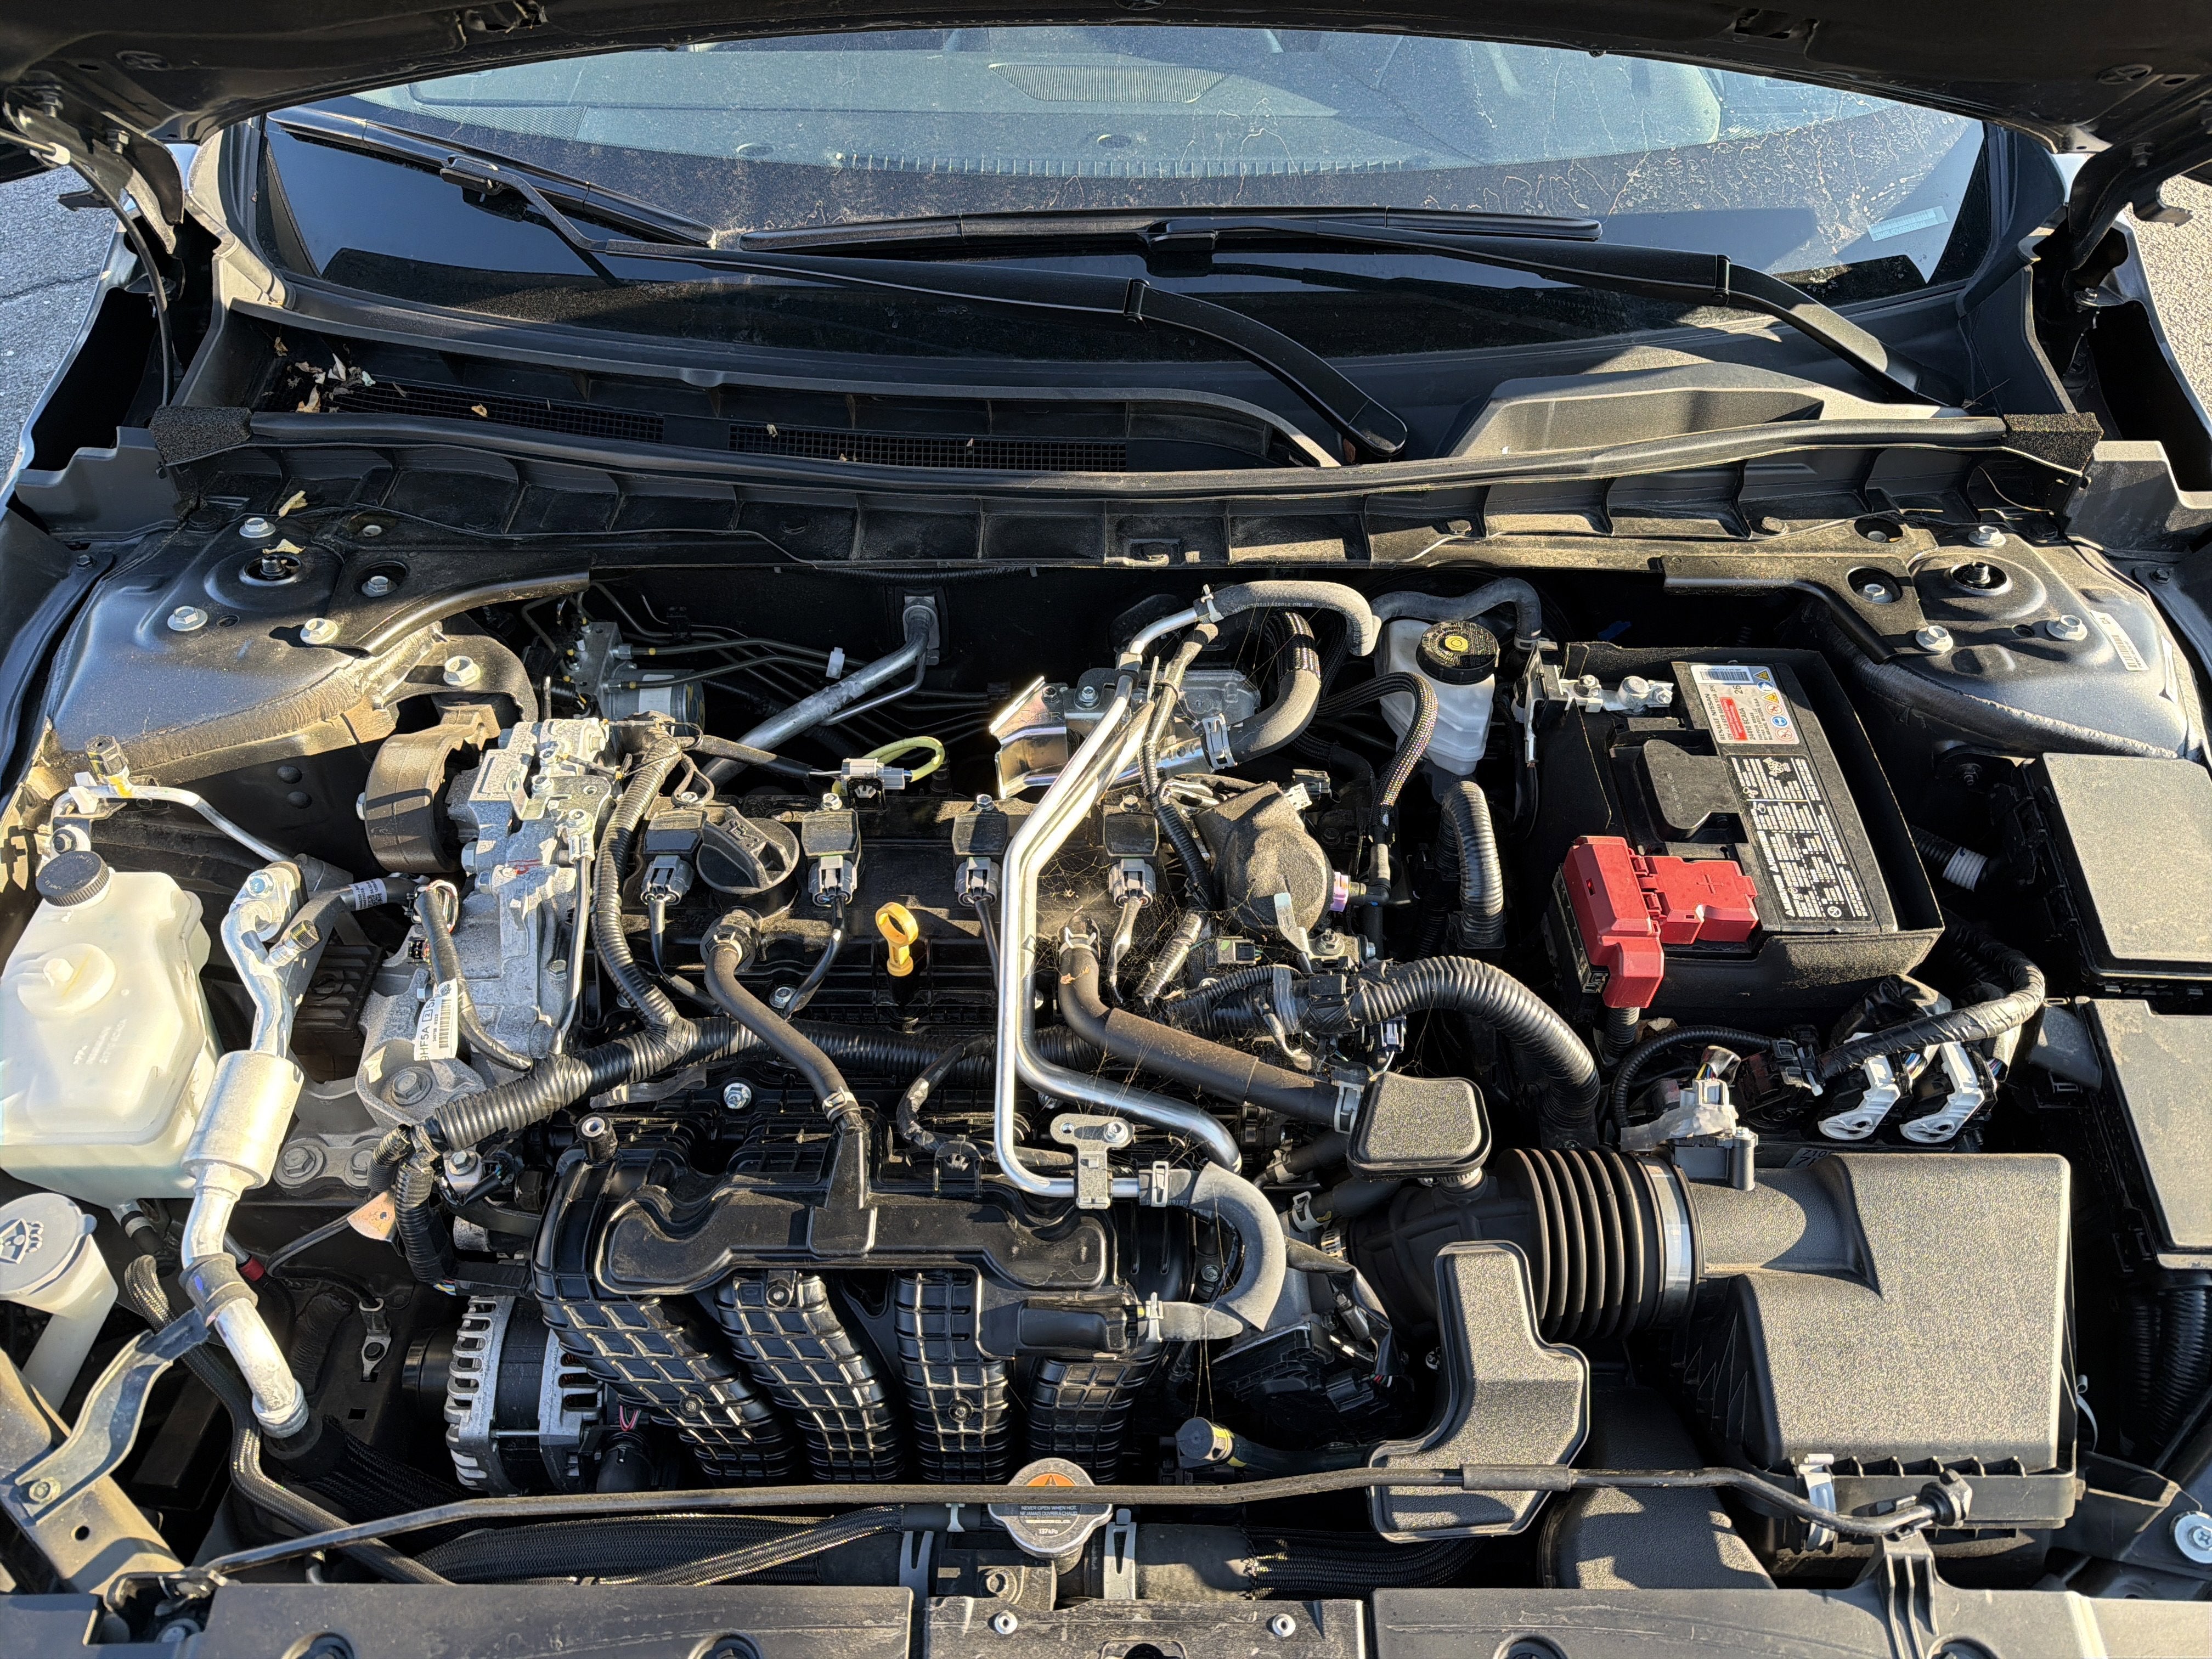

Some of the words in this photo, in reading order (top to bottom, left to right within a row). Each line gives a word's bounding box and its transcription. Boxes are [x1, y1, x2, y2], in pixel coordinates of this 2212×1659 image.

[1731, 685, 1743, 694] 26
[1704, 693, 1717, 715] NISSAN
[1713, 717, 1726, 740] RENAULT
